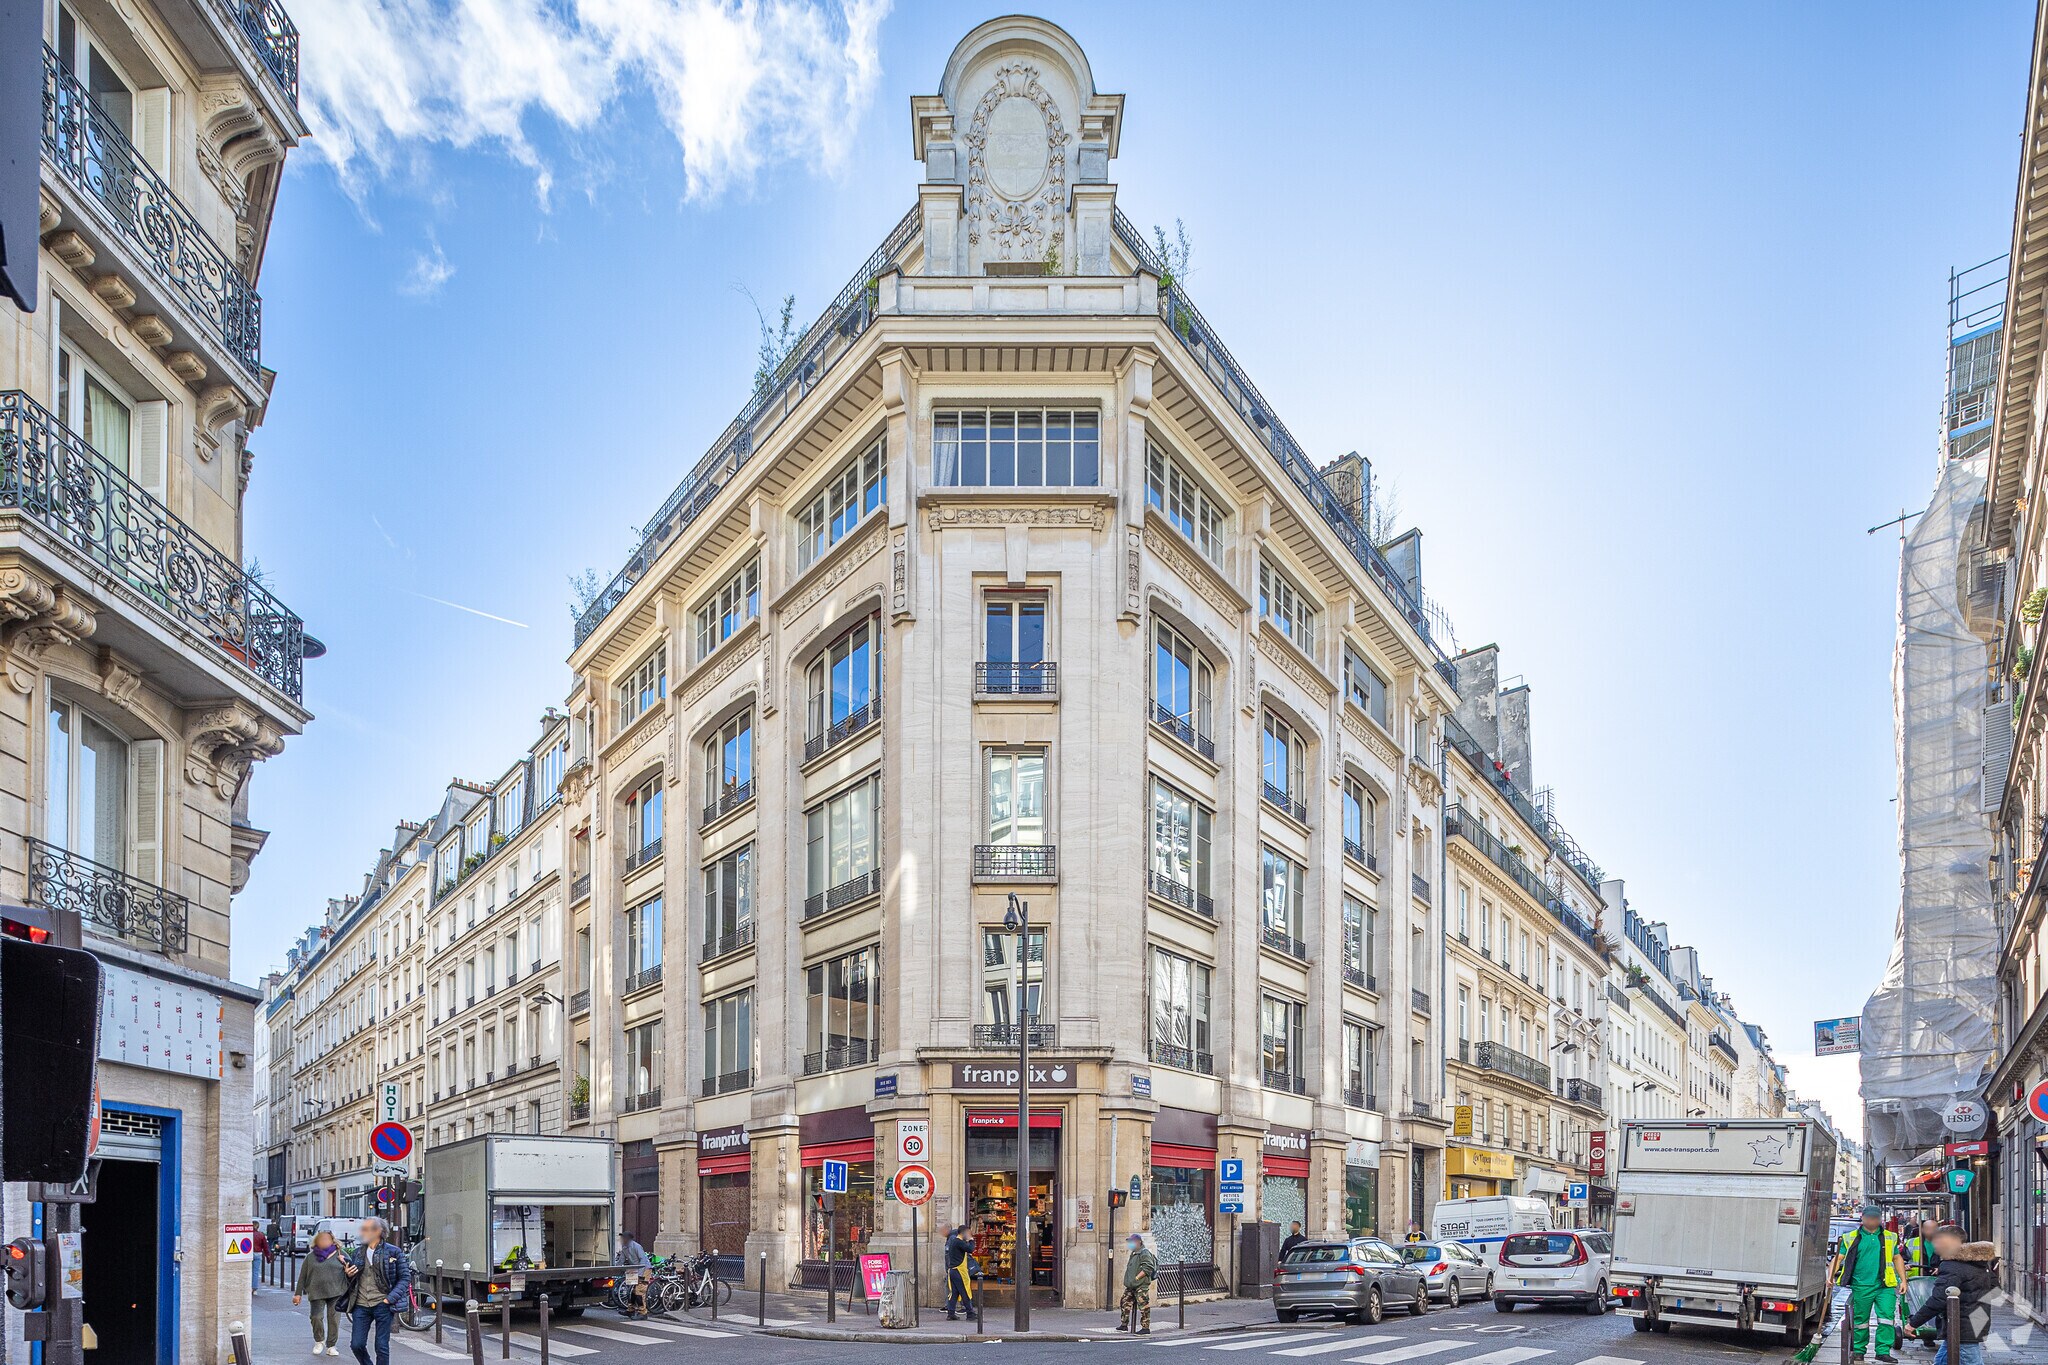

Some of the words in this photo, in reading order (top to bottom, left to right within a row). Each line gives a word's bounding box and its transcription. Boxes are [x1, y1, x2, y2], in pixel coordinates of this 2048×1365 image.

[962, 1064, 1048, 1086] franpix
[386, 1085, 396, 1121] HOT
[972, 1117, 999, 1125] franprix
[1947, 1113, 1981, 1123] HSBC
[701, 1129, 741, 1151] franprix
[907, 1141, 920, 1151] 30
[1644, 1146, 1720, 1154] www.ace-transport.com
[1346, 1157, 1360, 1165] JULES
[1226, 1163, 1238, 1178] P
[1573, 1186, 1583, 1197] P
[1440, 1221, 1471, 1231] STAAT
